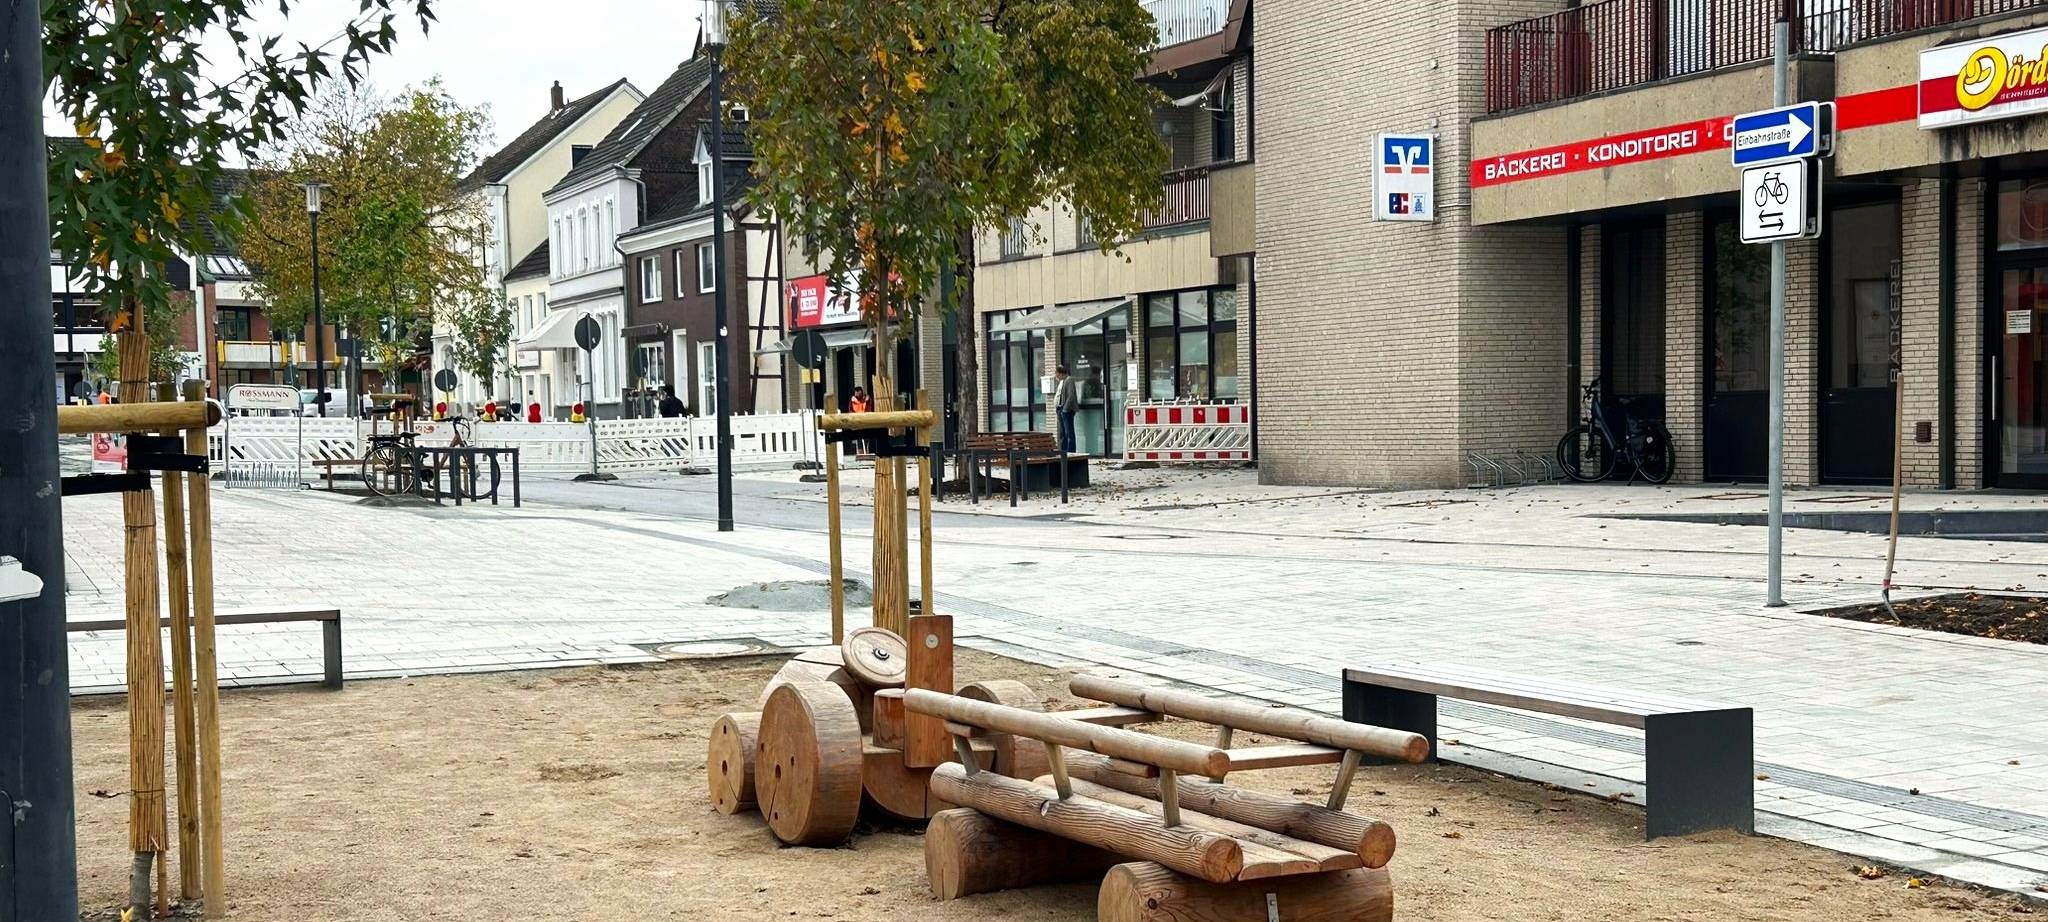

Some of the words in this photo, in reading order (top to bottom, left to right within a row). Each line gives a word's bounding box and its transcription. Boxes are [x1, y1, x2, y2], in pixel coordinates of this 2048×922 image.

[1485, 151, 1567, 180] BÄCKEREI
[1587, 129, 1697, 163] KONDITOREI
[1737, 128, 1791, 147] Einbahnstraße
[1888, 259, 1900, 383] BÄCKEREI
[239, 389, 289, 398] ROSSMANN
